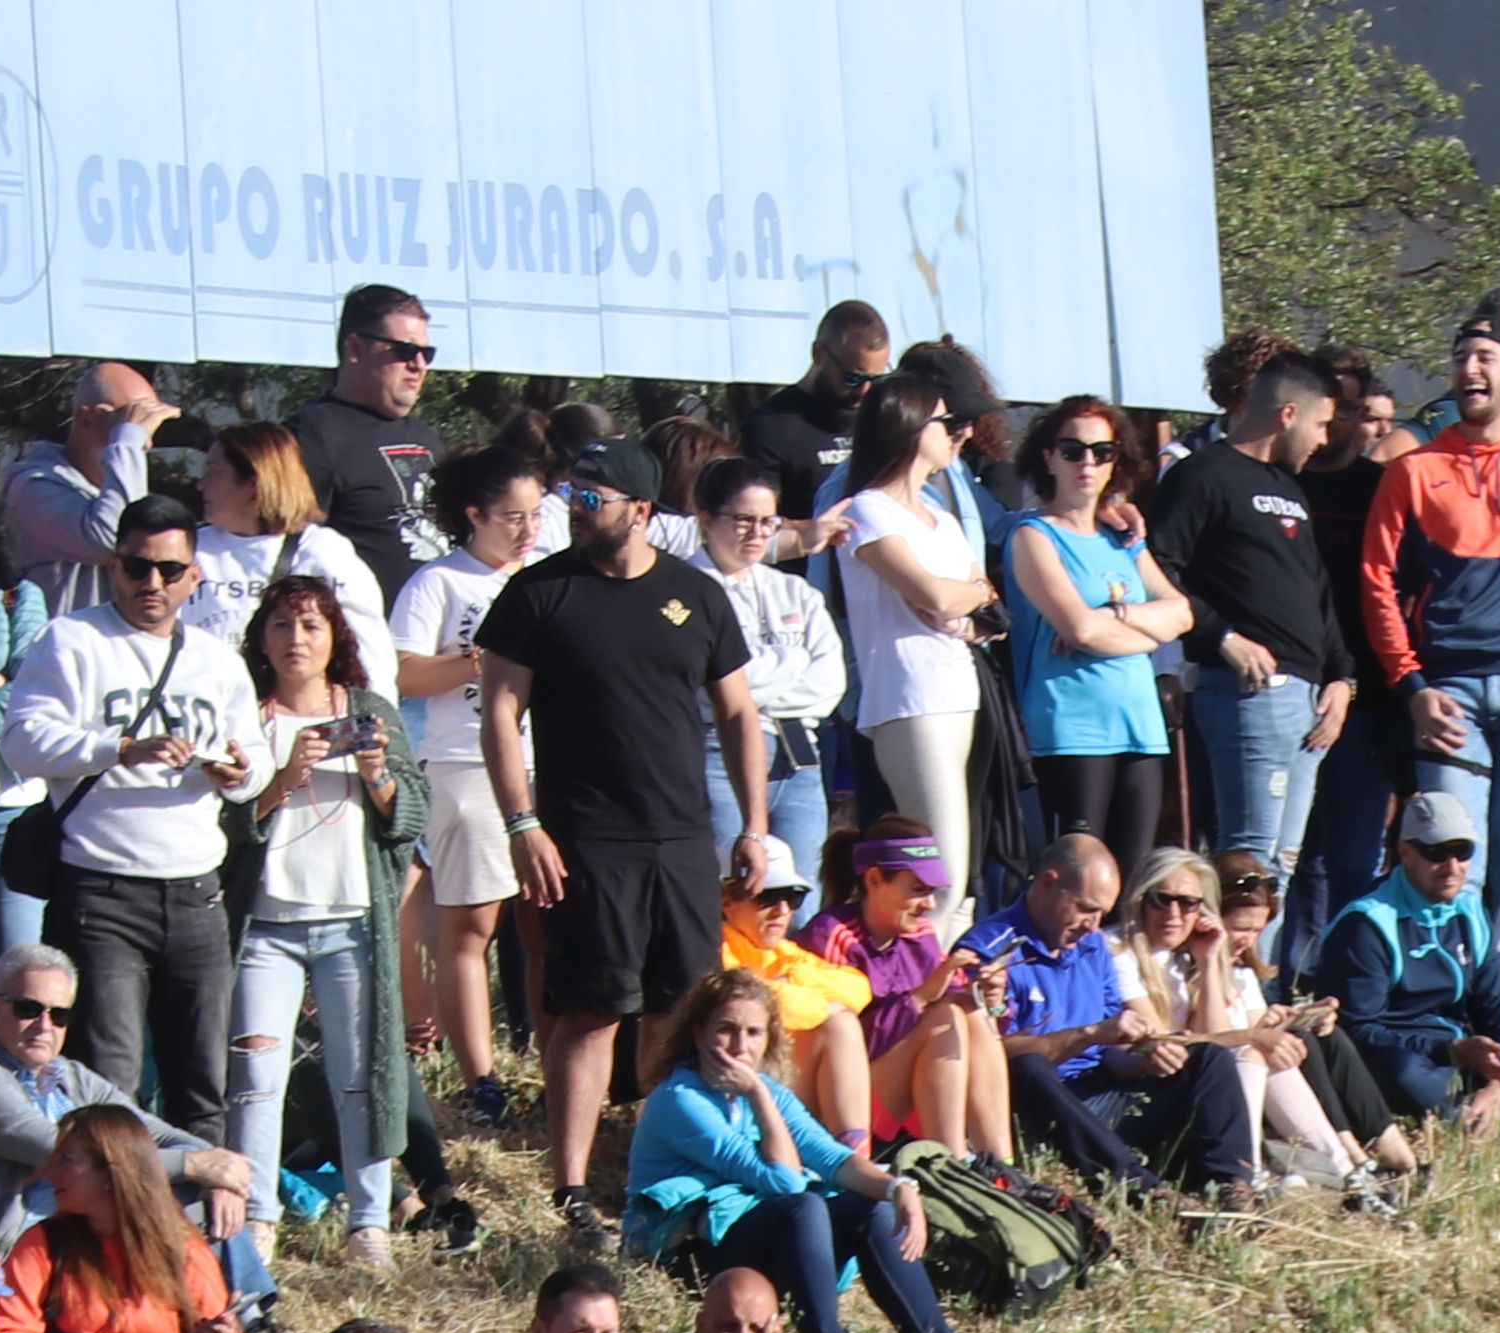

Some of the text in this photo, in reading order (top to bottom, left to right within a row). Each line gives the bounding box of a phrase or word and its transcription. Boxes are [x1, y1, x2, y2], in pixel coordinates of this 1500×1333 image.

[77, 154, 280, 260] GRUPO
[302, 172, 429, 268] RUIZ
[705, 191, 805, 281] S.A.
